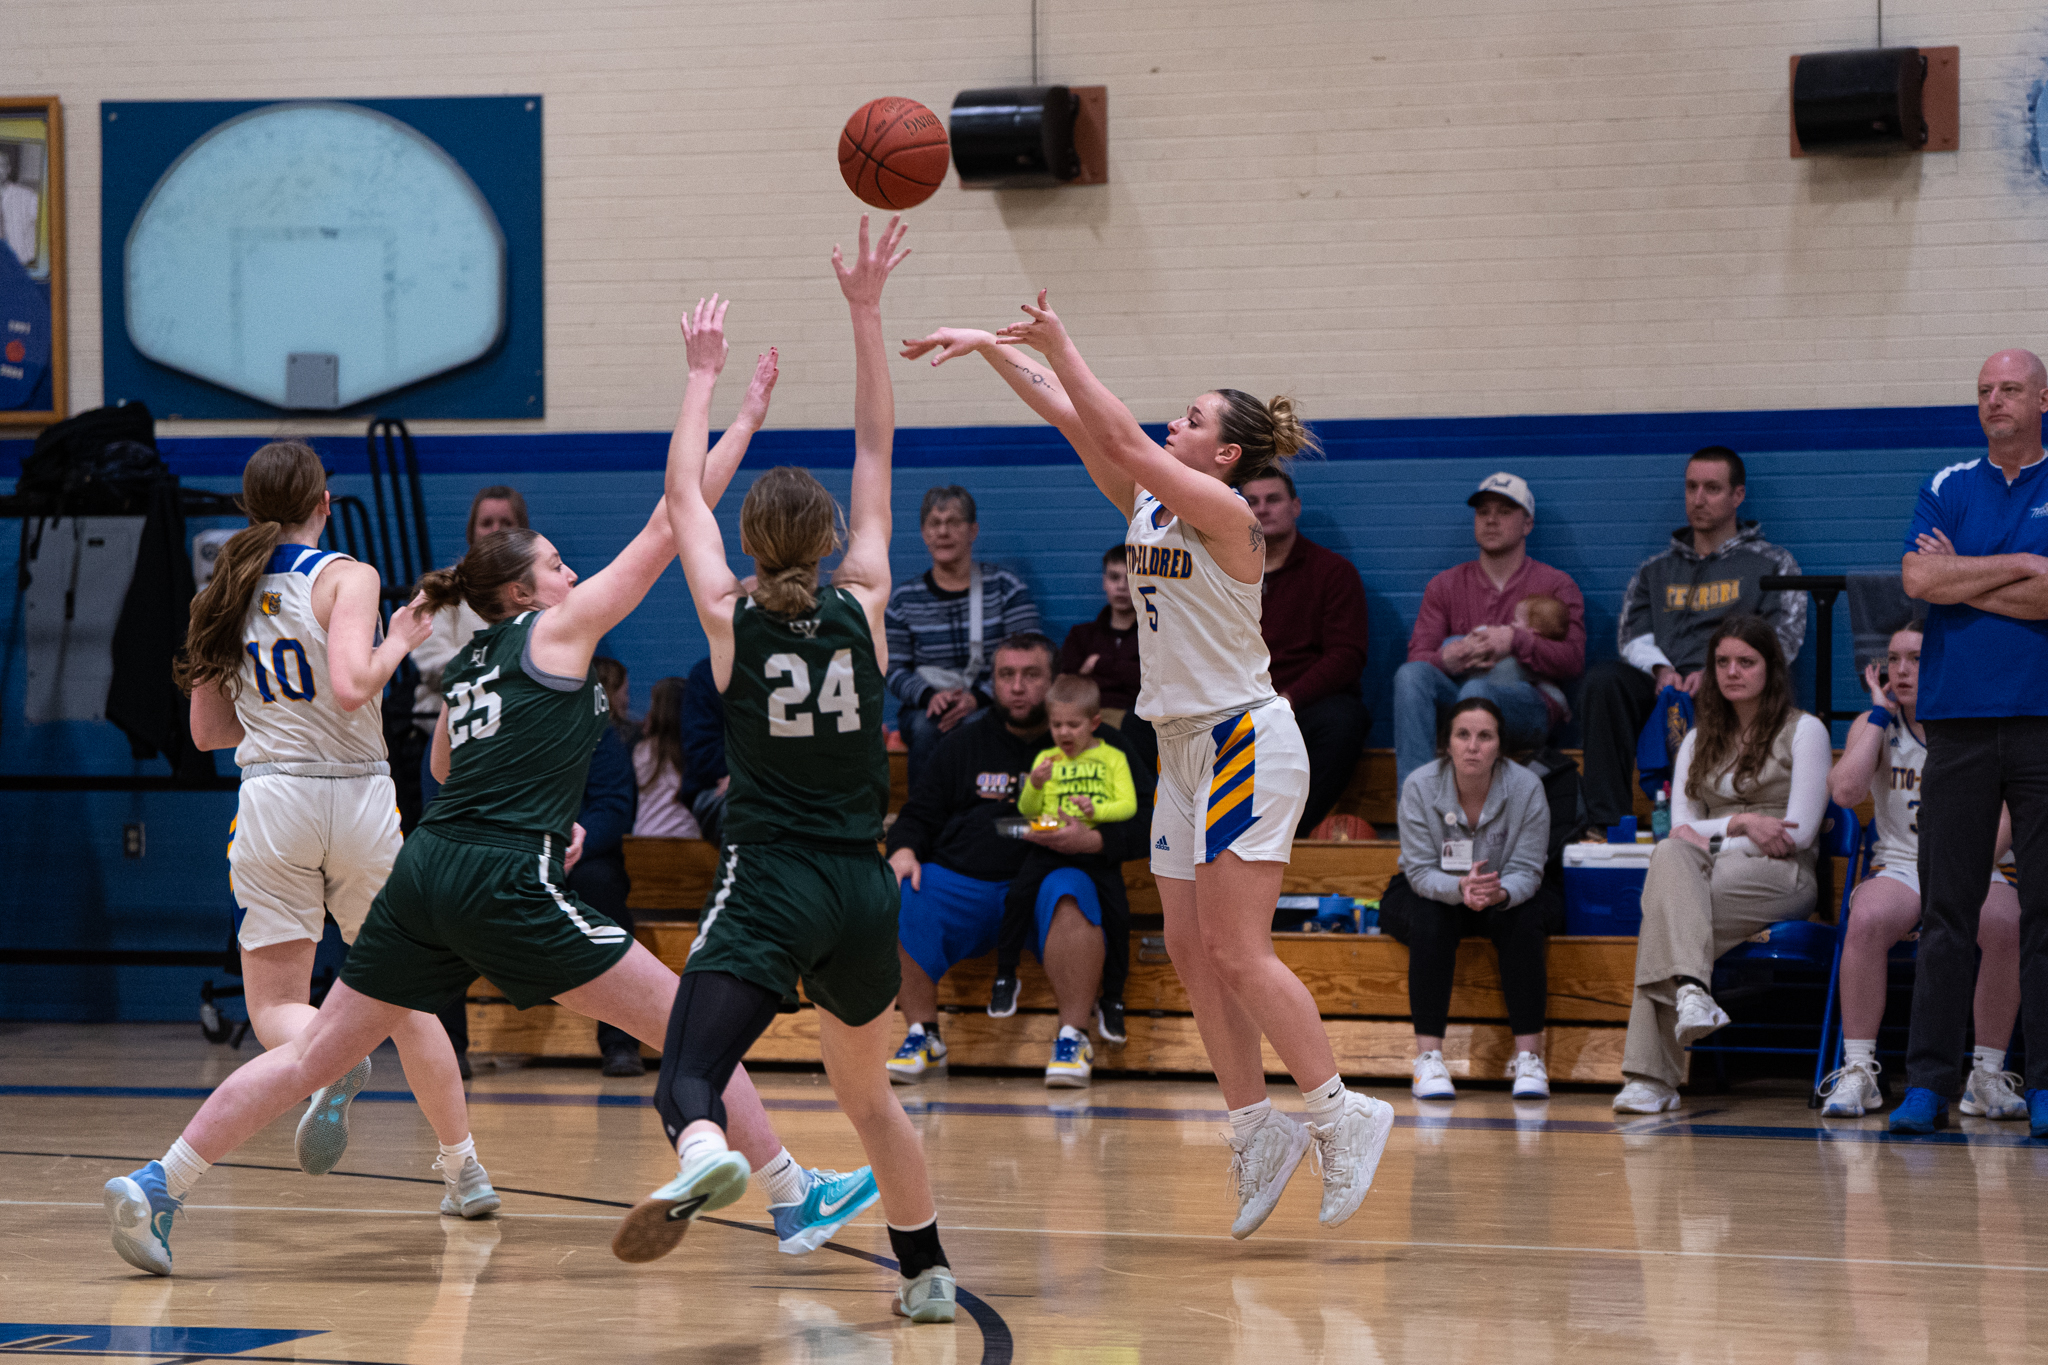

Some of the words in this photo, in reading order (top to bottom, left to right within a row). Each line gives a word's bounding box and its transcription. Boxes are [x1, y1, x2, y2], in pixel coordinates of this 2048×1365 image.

[1138, 586, 1158, 633] 5
[246, 638, 317, 704] 10
[764, 648, 861, 737] 24
[447, 665, 502, 749] 25
[1060, 763, 1107, 780] LEAVE
